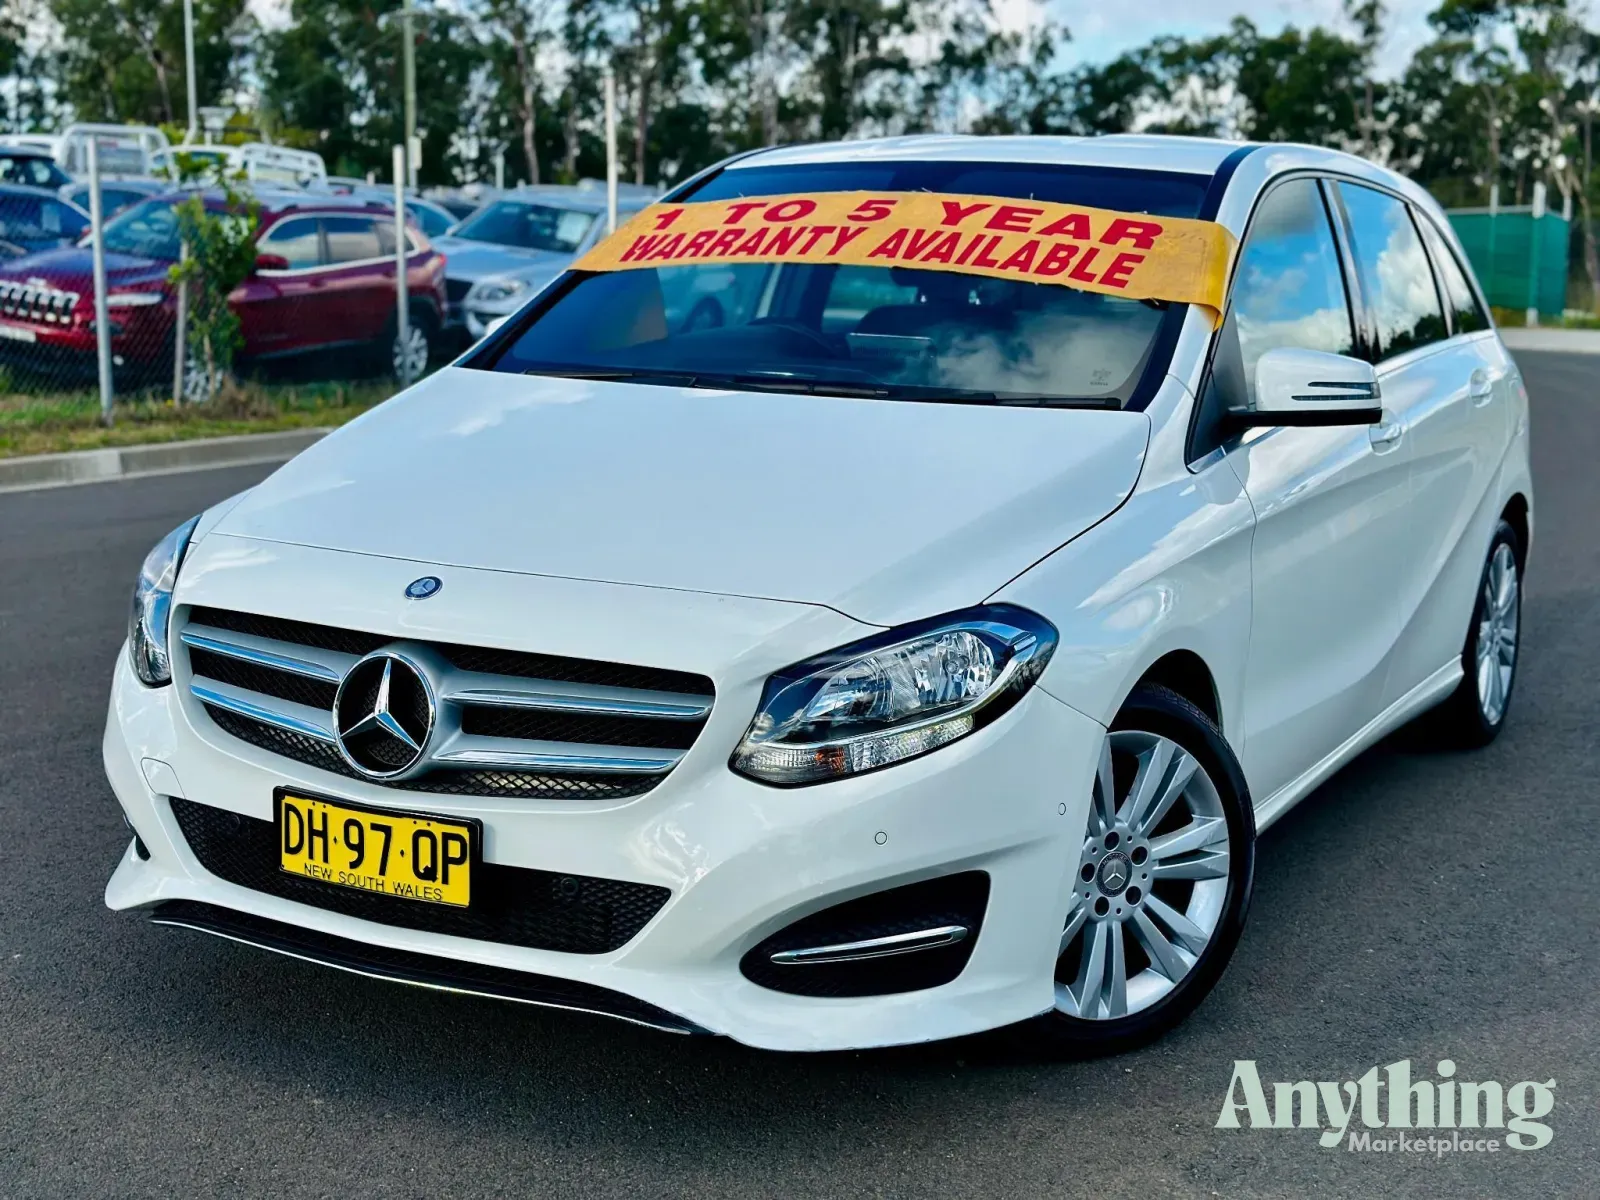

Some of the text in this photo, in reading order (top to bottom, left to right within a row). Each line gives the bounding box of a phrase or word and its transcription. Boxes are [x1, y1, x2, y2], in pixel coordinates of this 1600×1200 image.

[653, 199, 1164, 250] 1 TO 5 YEAR
[619, 226, 1146, 289] WARRANTY AVAILABLE
[304, 862, 443, 901] NEW SOUTH WALES
